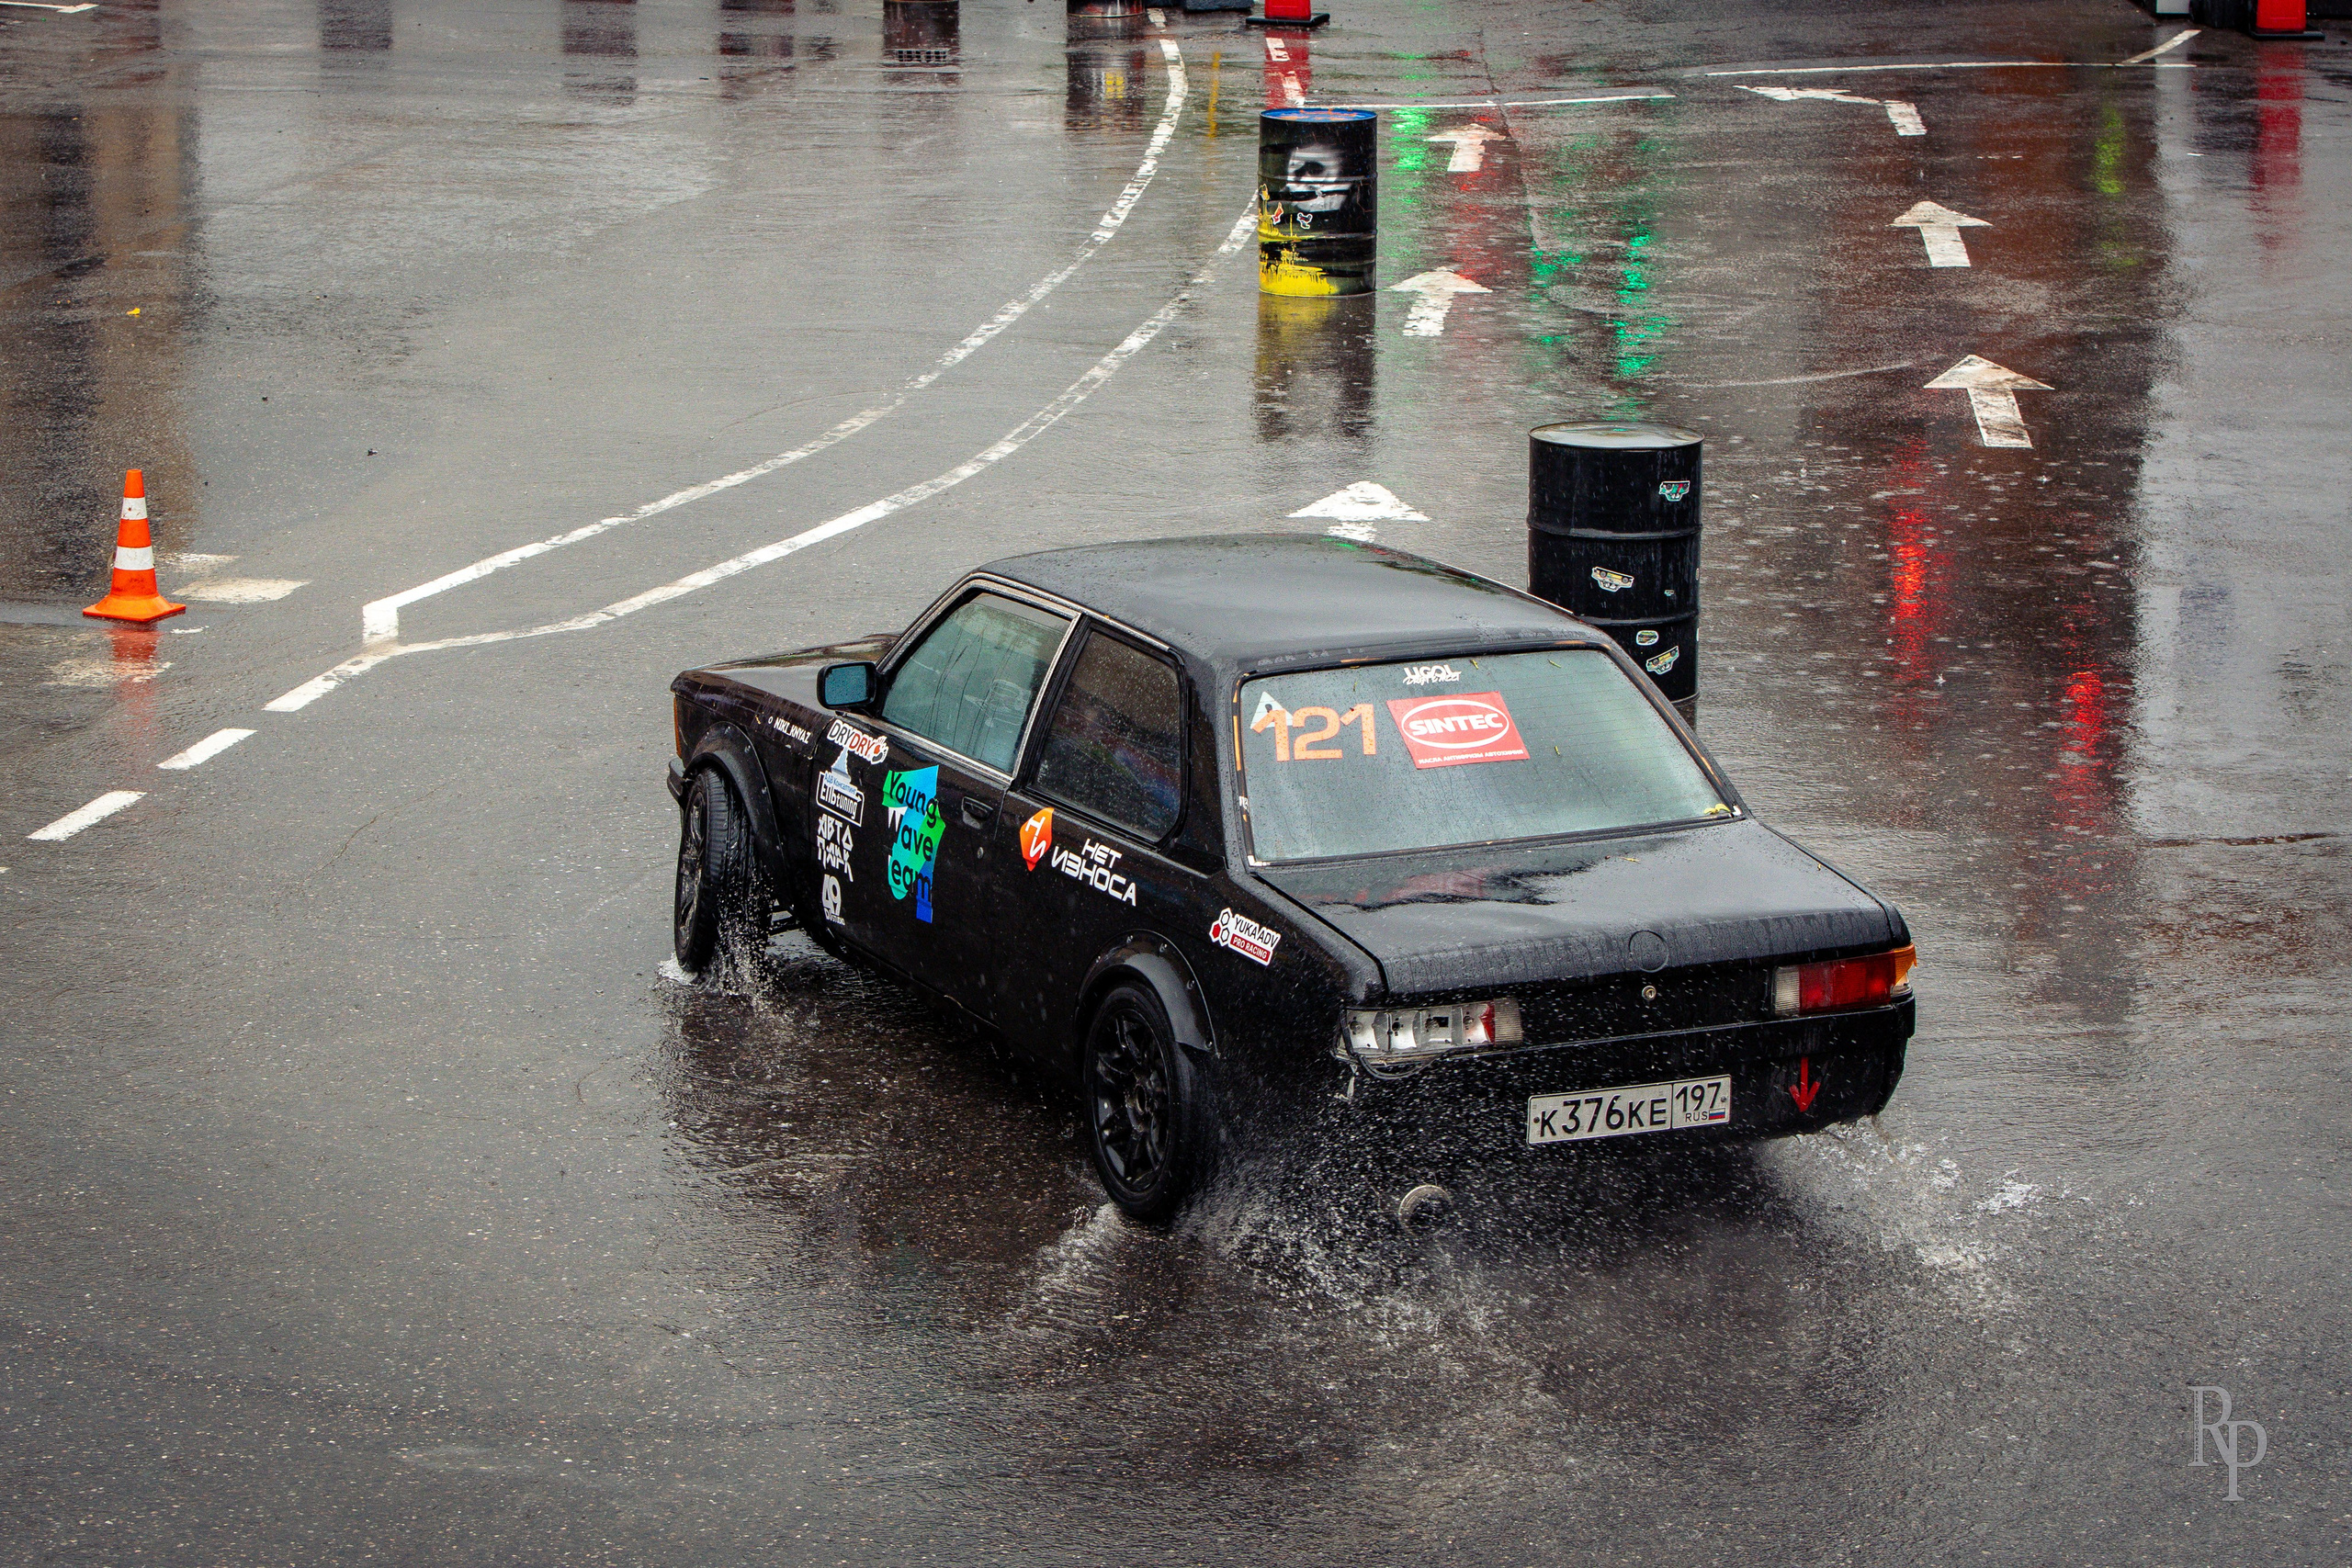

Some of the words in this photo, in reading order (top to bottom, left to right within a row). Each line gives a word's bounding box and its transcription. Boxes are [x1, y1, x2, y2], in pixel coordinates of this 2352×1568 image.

[1251, 704, 1376, 761] 121
[1408, 713, 1504, 737] SINTEC
[890, 770, 938, 829] Young
[1081, 838, 1123, 869] НЕТ
[1051, 845, 1136, 907] ИЗНОСА
[1232, 936, 1246, 948] PRO
[1244, 942, 1268, 959] RACING
[1675, 1081, 1721, 1113] 197
[1685, 1111, 1708, 1122] RUS
